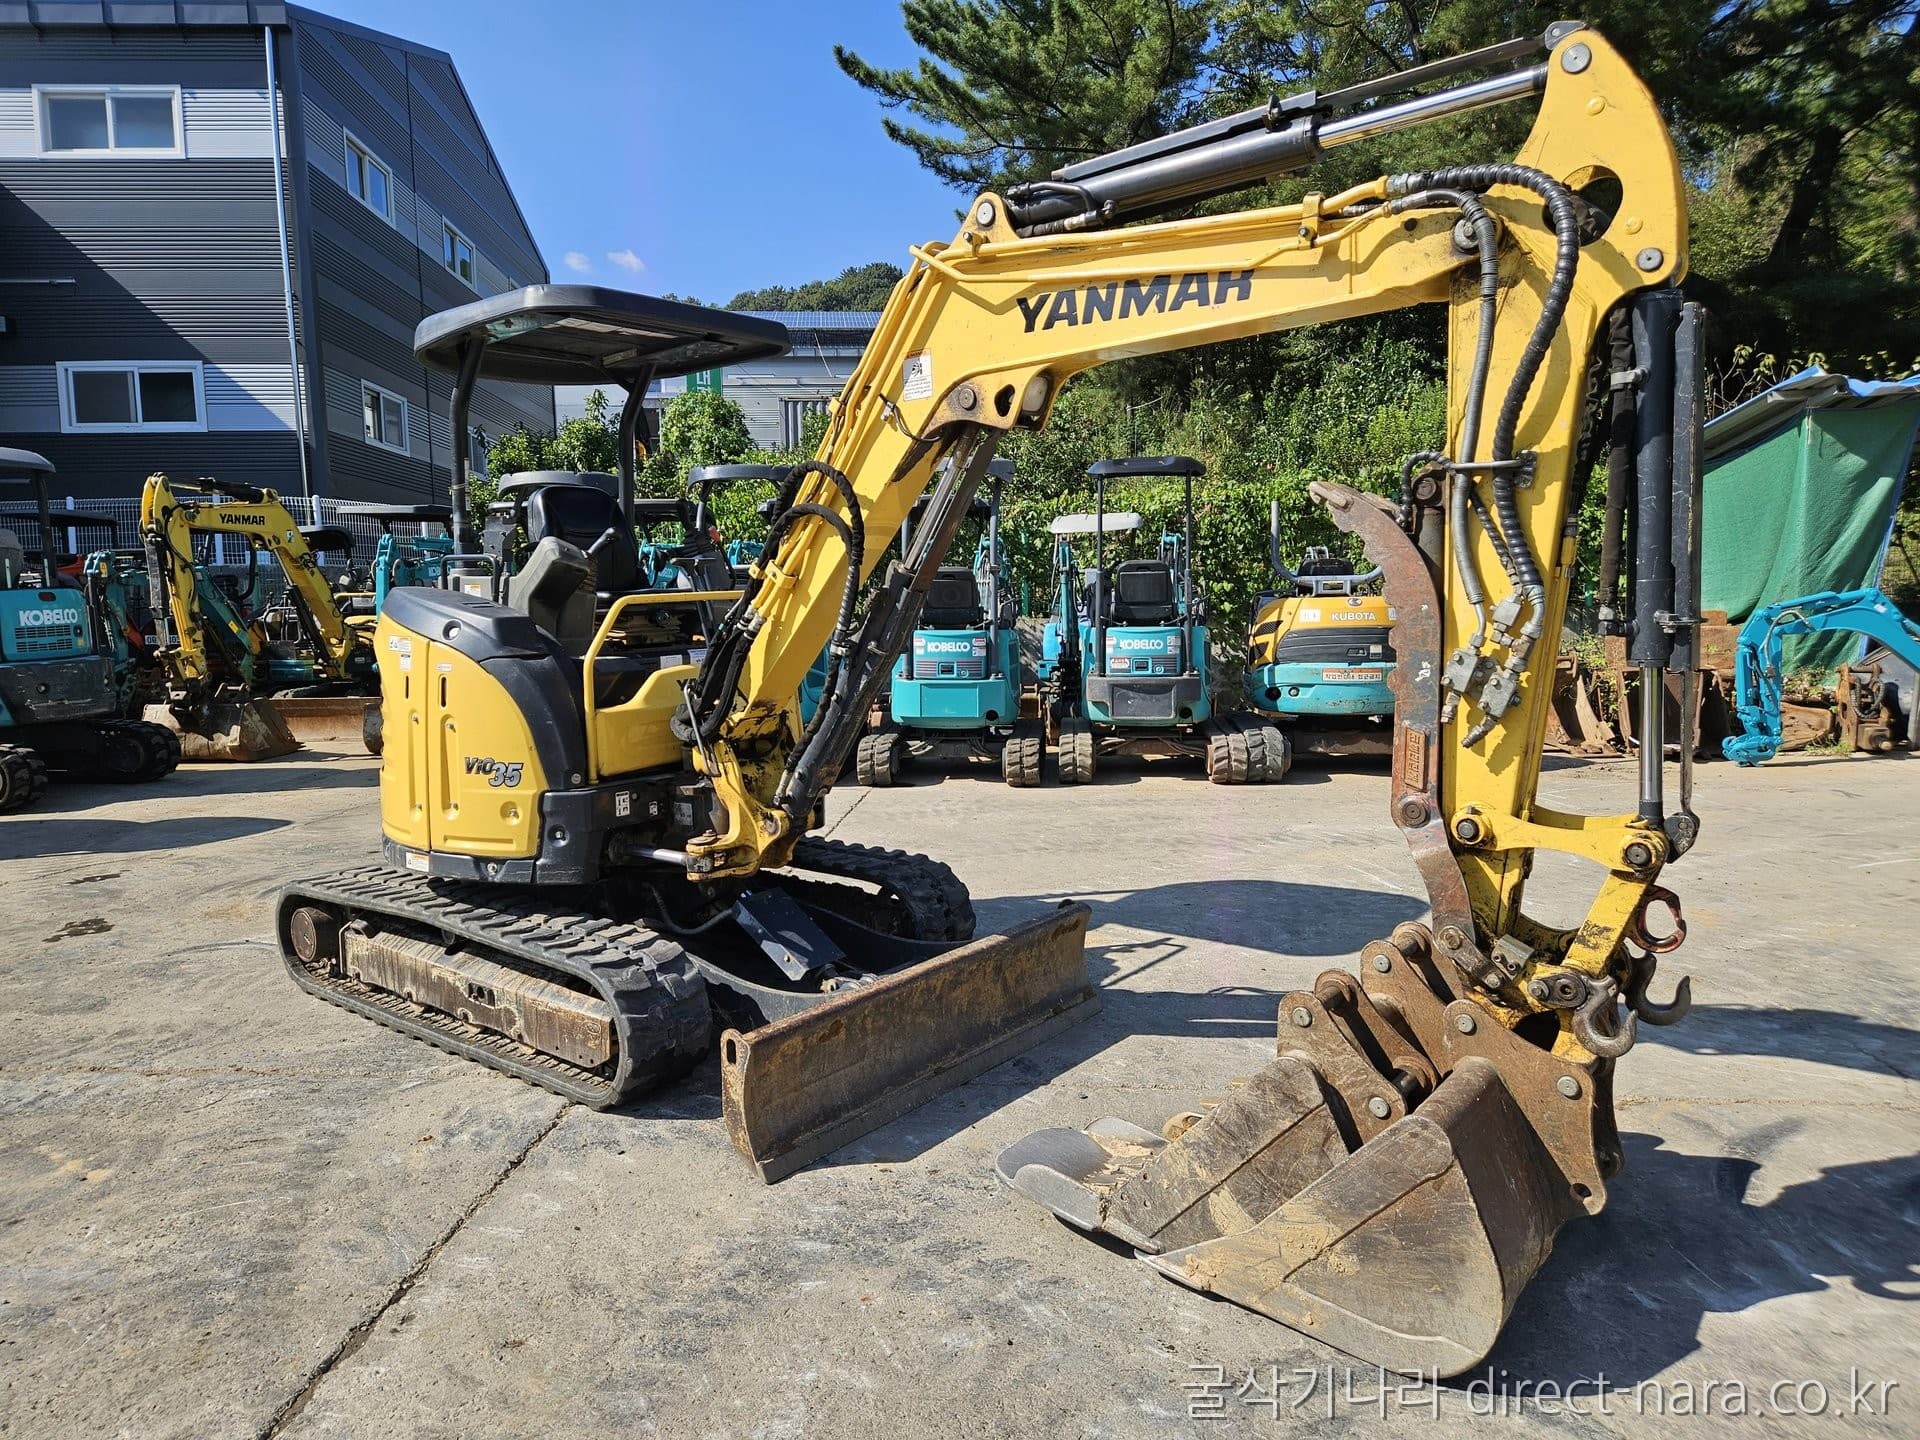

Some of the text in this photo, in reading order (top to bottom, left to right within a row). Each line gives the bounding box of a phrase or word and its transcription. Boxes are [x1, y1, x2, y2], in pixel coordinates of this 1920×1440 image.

[1016, 269, 1255, 333] YANMAR
[219, 513, 266, 526] YANMAR
[19, 608, 78, 627] KOBELCO
[1331, 612, 1376, 621] KUBOTA
[927, 641, 970, 653] KOBELCO
[1120, 639, 1163, 650] KOBELCO
